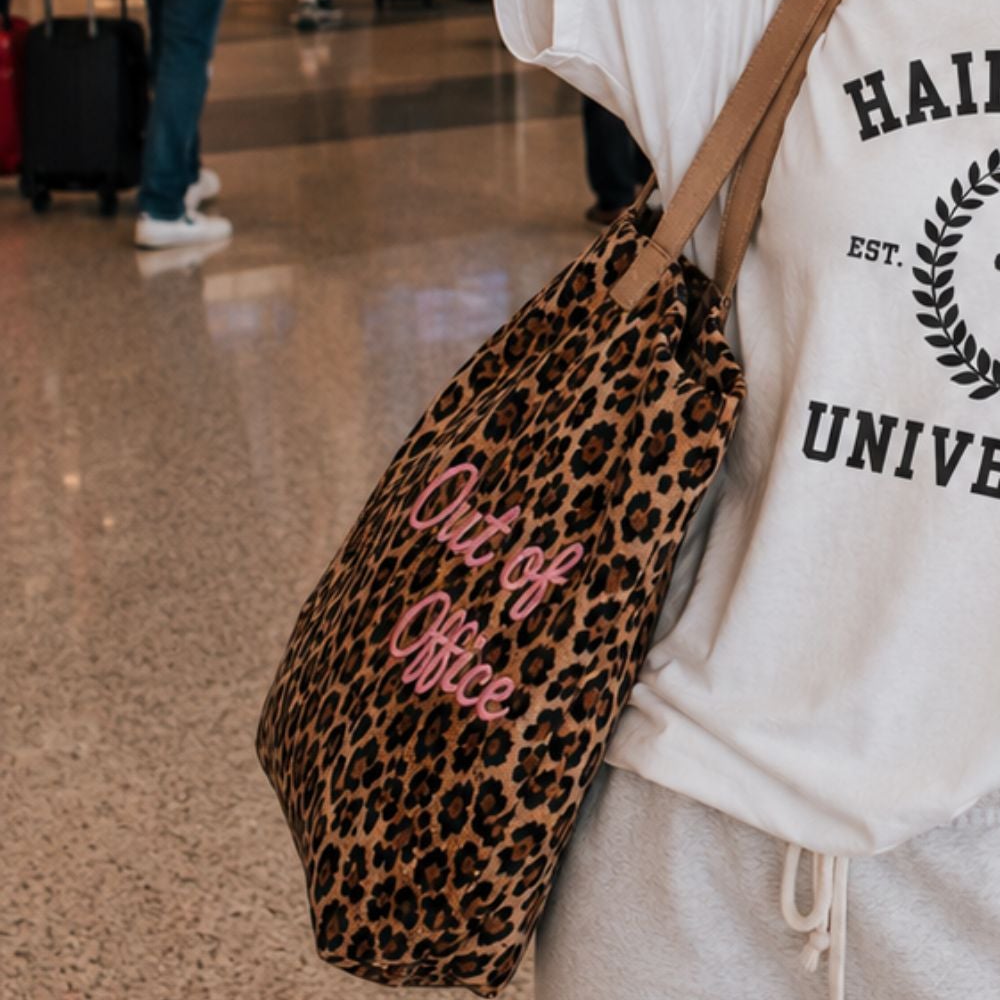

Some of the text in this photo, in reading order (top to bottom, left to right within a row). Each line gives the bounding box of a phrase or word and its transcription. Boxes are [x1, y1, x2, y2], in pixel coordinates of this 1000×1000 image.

[846, 235, 904, 267] EST.
[409, 462, 584, 621] Out of
[390, 590, 516, 722] Office
